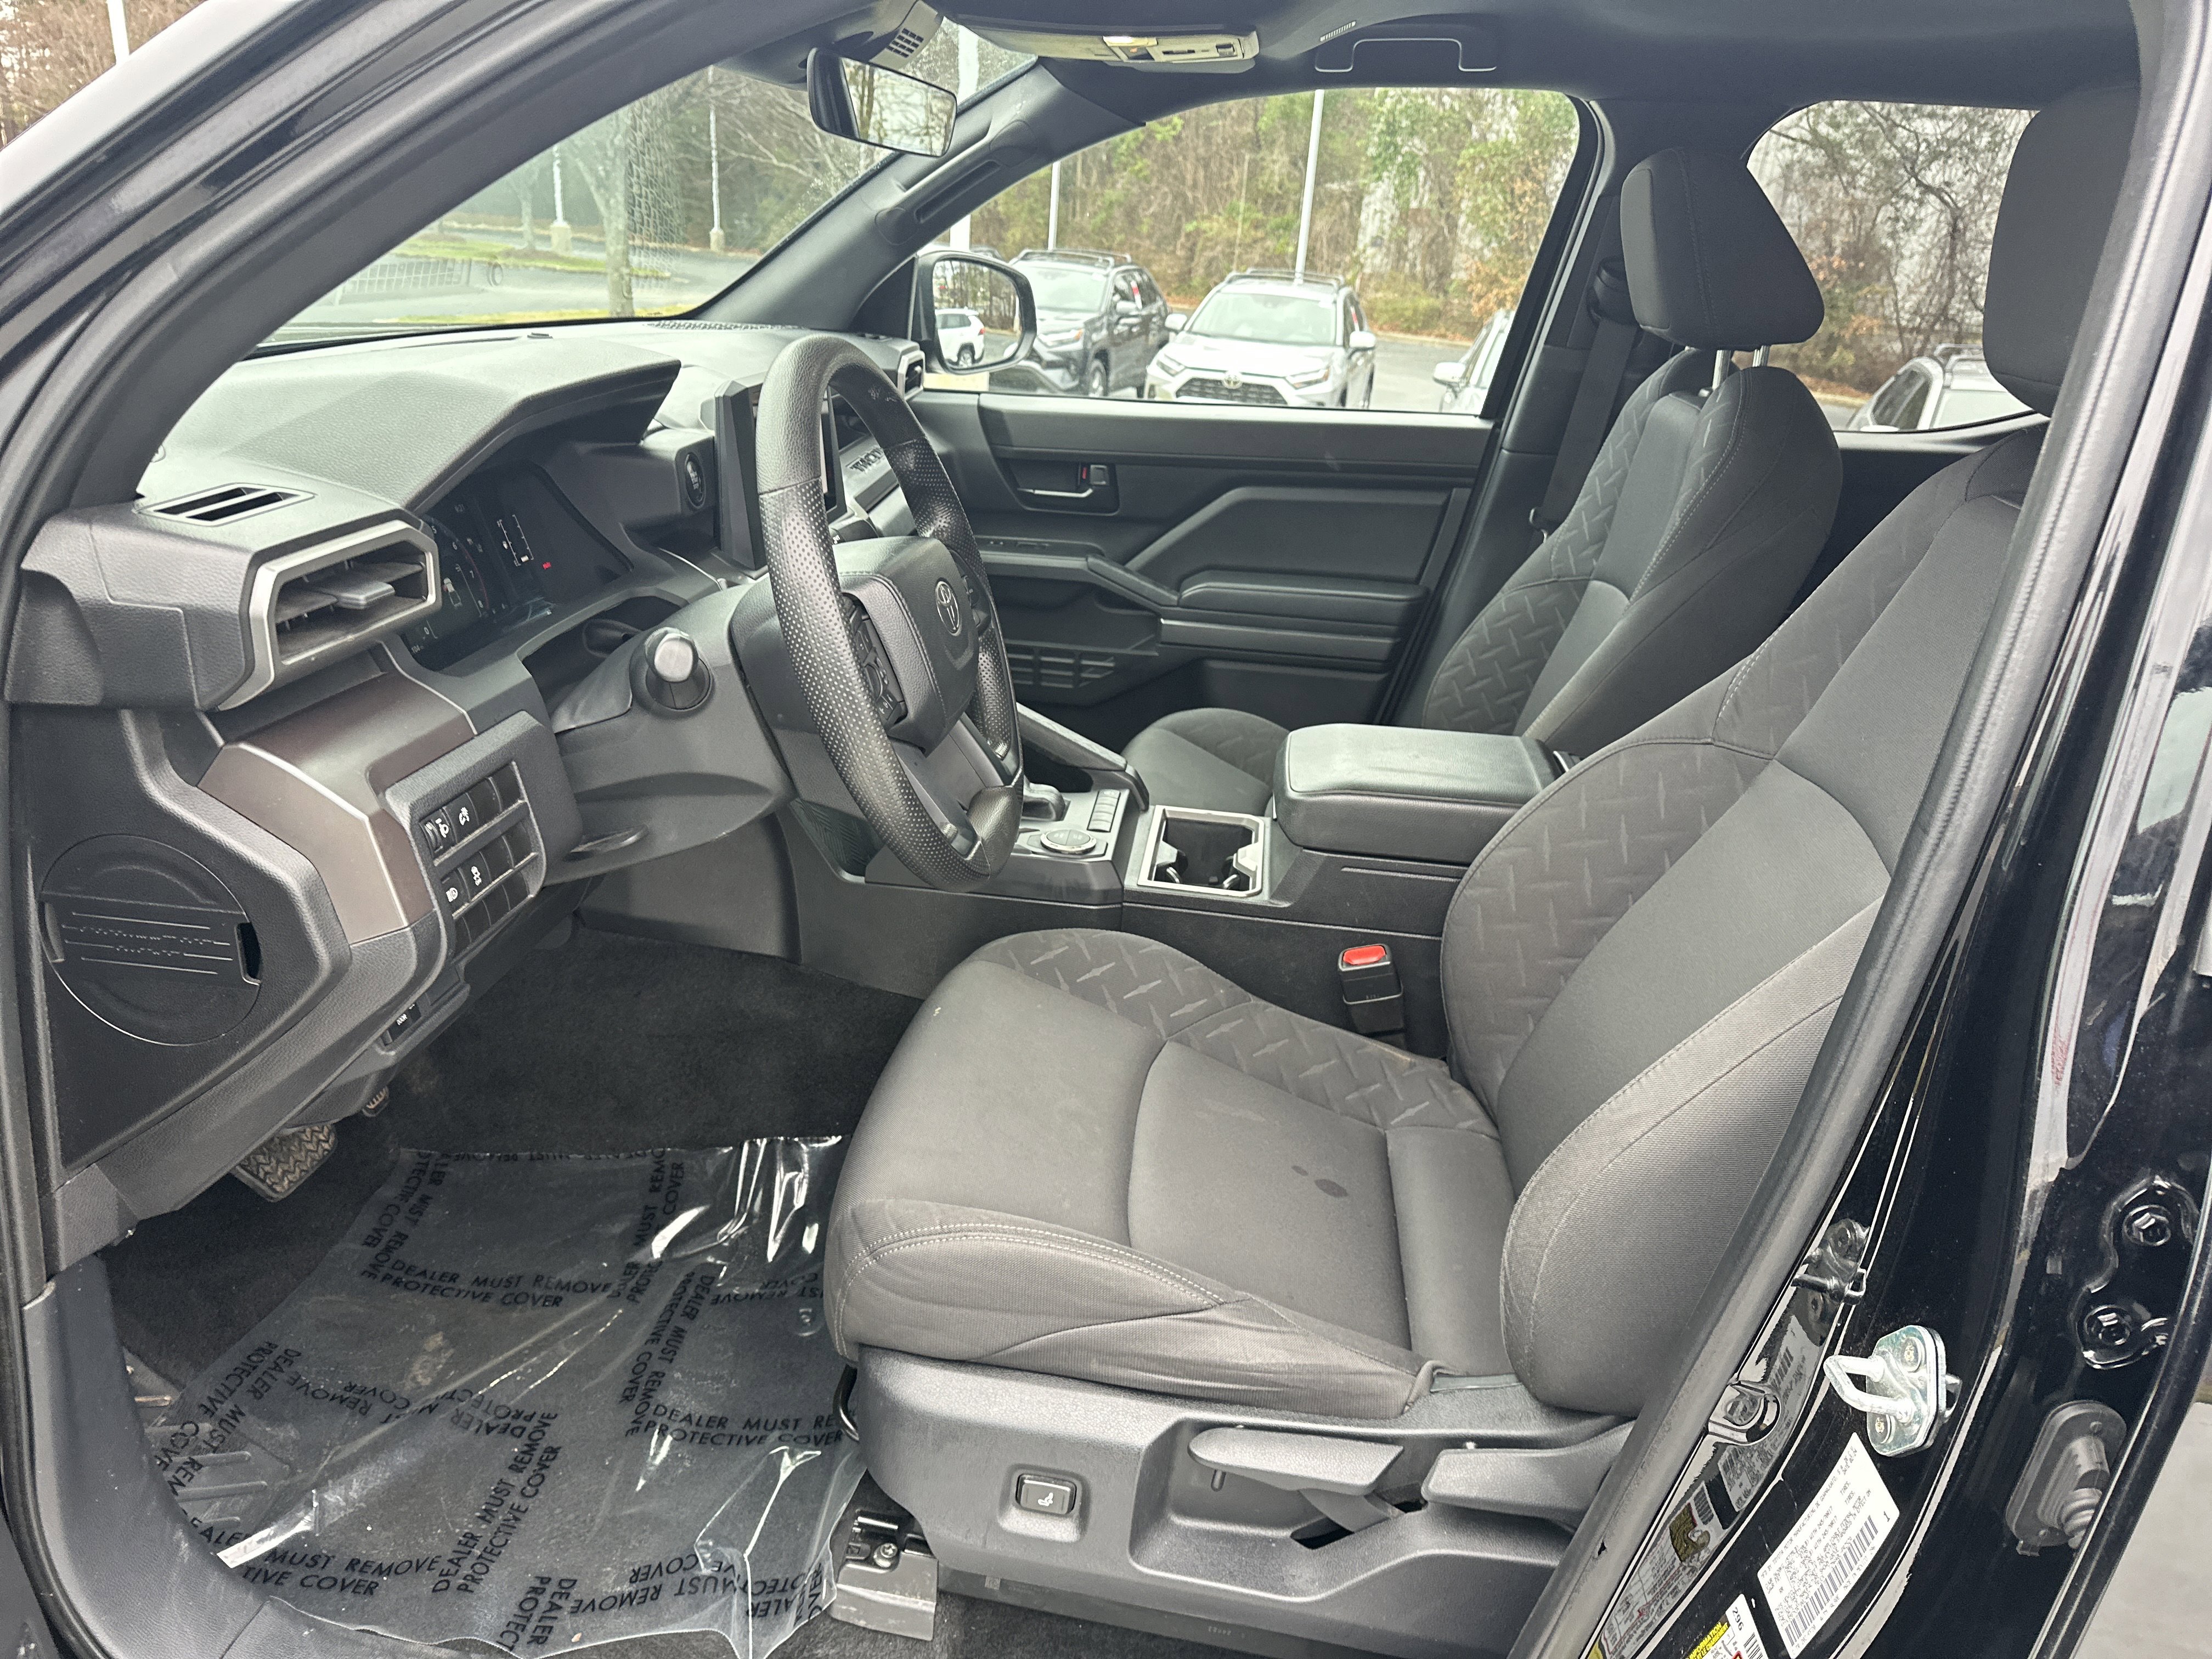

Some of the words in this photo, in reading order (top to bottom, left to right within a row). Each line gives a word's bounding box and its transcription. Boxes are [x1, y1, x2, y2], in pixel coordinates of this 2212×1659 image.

[662, 1162, 684, 1215] COVER
[380, 1272, 493, 1303] PROTECTIVE
[500, 1291, 563, 1307] COVER
[392, 1260, 460, 1283] DEALER
[471, 1274, 523, 1289] MUST
[679, 1273, 715, 1321] DEALER
[657, 1325, 687, 1364] MUST
[246, 1349, 301, 1401] DEALER
[285, 1371, 373, 1416] REMOVE
[618, 1351, 653, 1404] COVER
[343, 1383, 410, 1410] COVER
[625, 1370, 667, 1438] REMOVE
[202, 1404, 246, 1449] MUST
[450, 1408, 527, 1438] DEALER
[644, 1420, 771, 1446] PROTECTIVE
[778, 1430, 843, 1447] COVER
[652, 1404, 729, 1430] DEALER
[742, 1415, 802, 1432] MUST
[154, 1420, 199, 1471] COVE
[431, 1532, 483, 1593] DEALER
[475, 1478, 516, 1524] MUST
[508, 1413, 558, 1474] REMOVE
[455, 1503, 530, 1593] PROTECTIVE
[520, 1446, 562, 1499] COVER
[1882, 1508, 1891, 1523] 1
[263, 1548, 336, 1571] MUST
[343, 1555, 442, 1579] REMOVE
[299, 1574, 380, 1595] COVER
[496, 1576, 552, 1652] PROTECT
[526, 1578, 578, 1645] DEALER
[568, 1584, 663, 1615] REMOVE
[1732, 1606, 1744, 1632] 296
